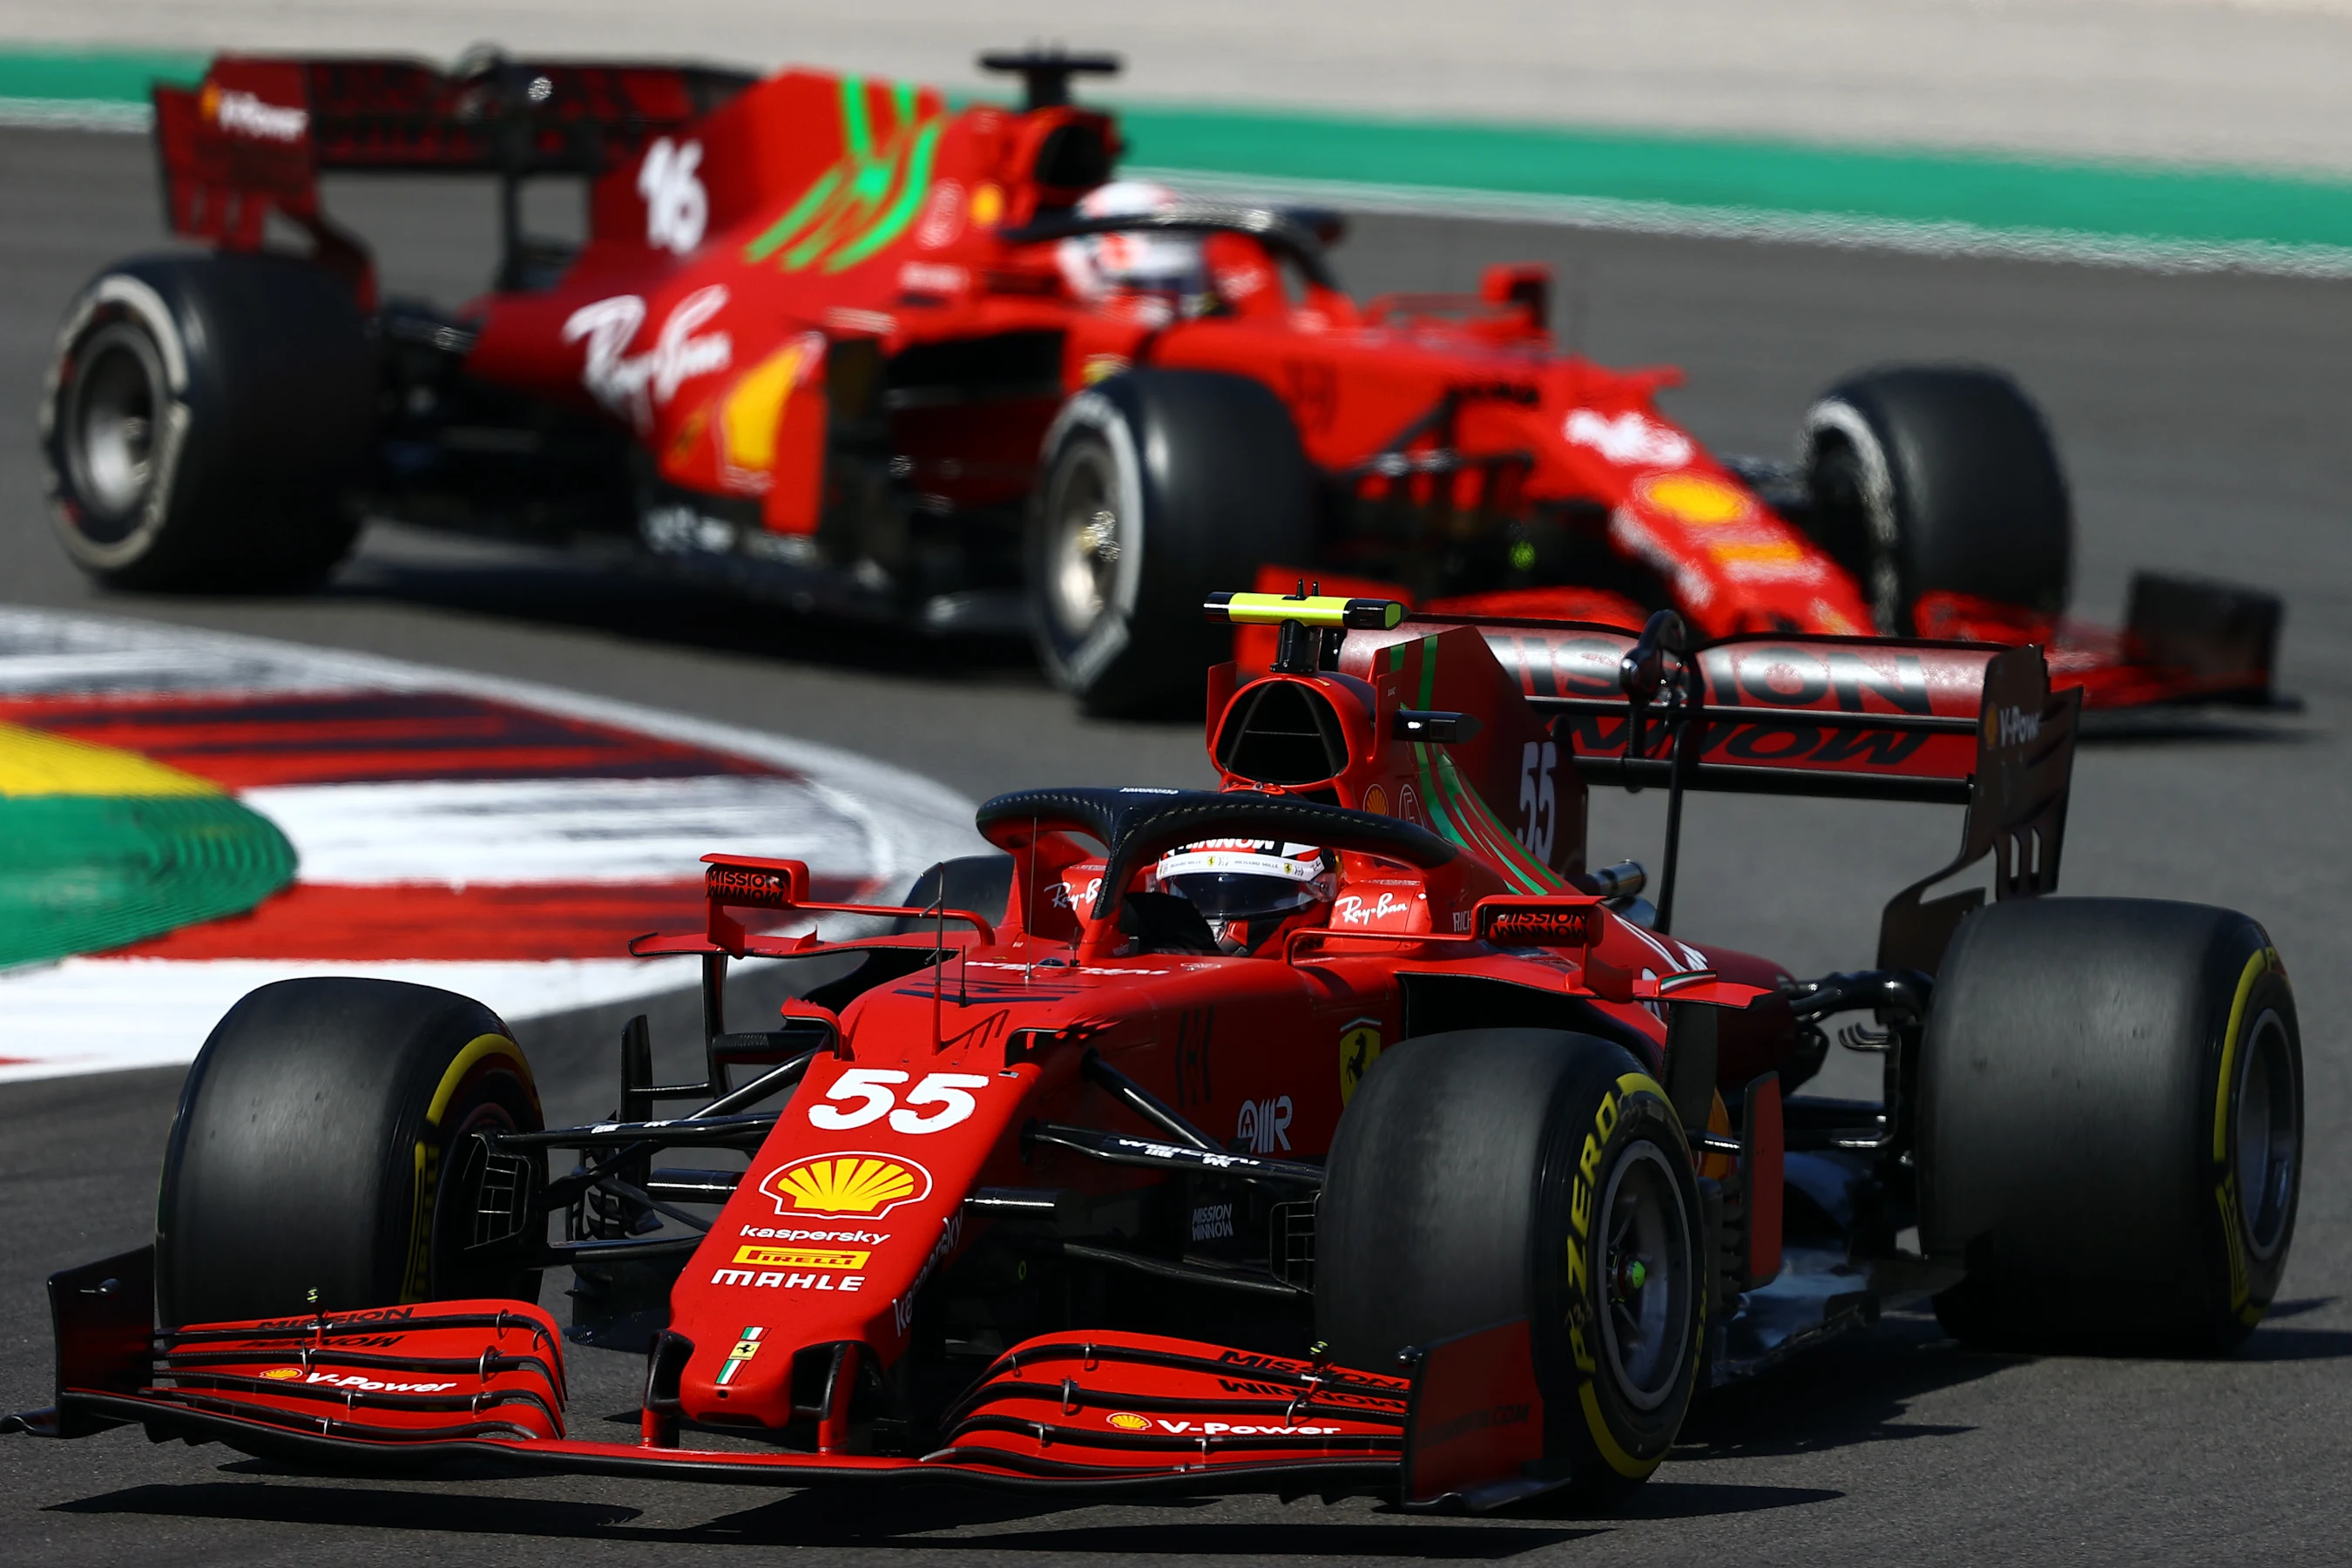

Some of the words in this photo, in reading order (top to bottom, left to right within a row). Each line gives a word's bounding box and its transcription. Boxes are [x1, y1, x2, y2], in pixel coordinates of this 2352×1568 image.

[637, 136, 708, 254] 16
[1517, 741, 1557, 867] 55
[709, 871, 784, 889] MISSION
[707, 885, 784, 902] WINNOW
[1044, 877, 1104, 912] Ray-B
[808, 1069, 990, 1134] 55
[1567, 1090, 1619, 1298] ZERO
[1193, 1203, 1233, 1224] MISSION
[740, 1225, 891, 1245] kaspersky
[1193, 1220, 1233, 1241] WINNOW
[747, 1250, 856, 1265] PIRELLI
[711, 1269, 865, 1291] MAHLE
[305, 1372, 457, 1393] V-Power
[1157, 1420, 1342, 1436] V-Power
